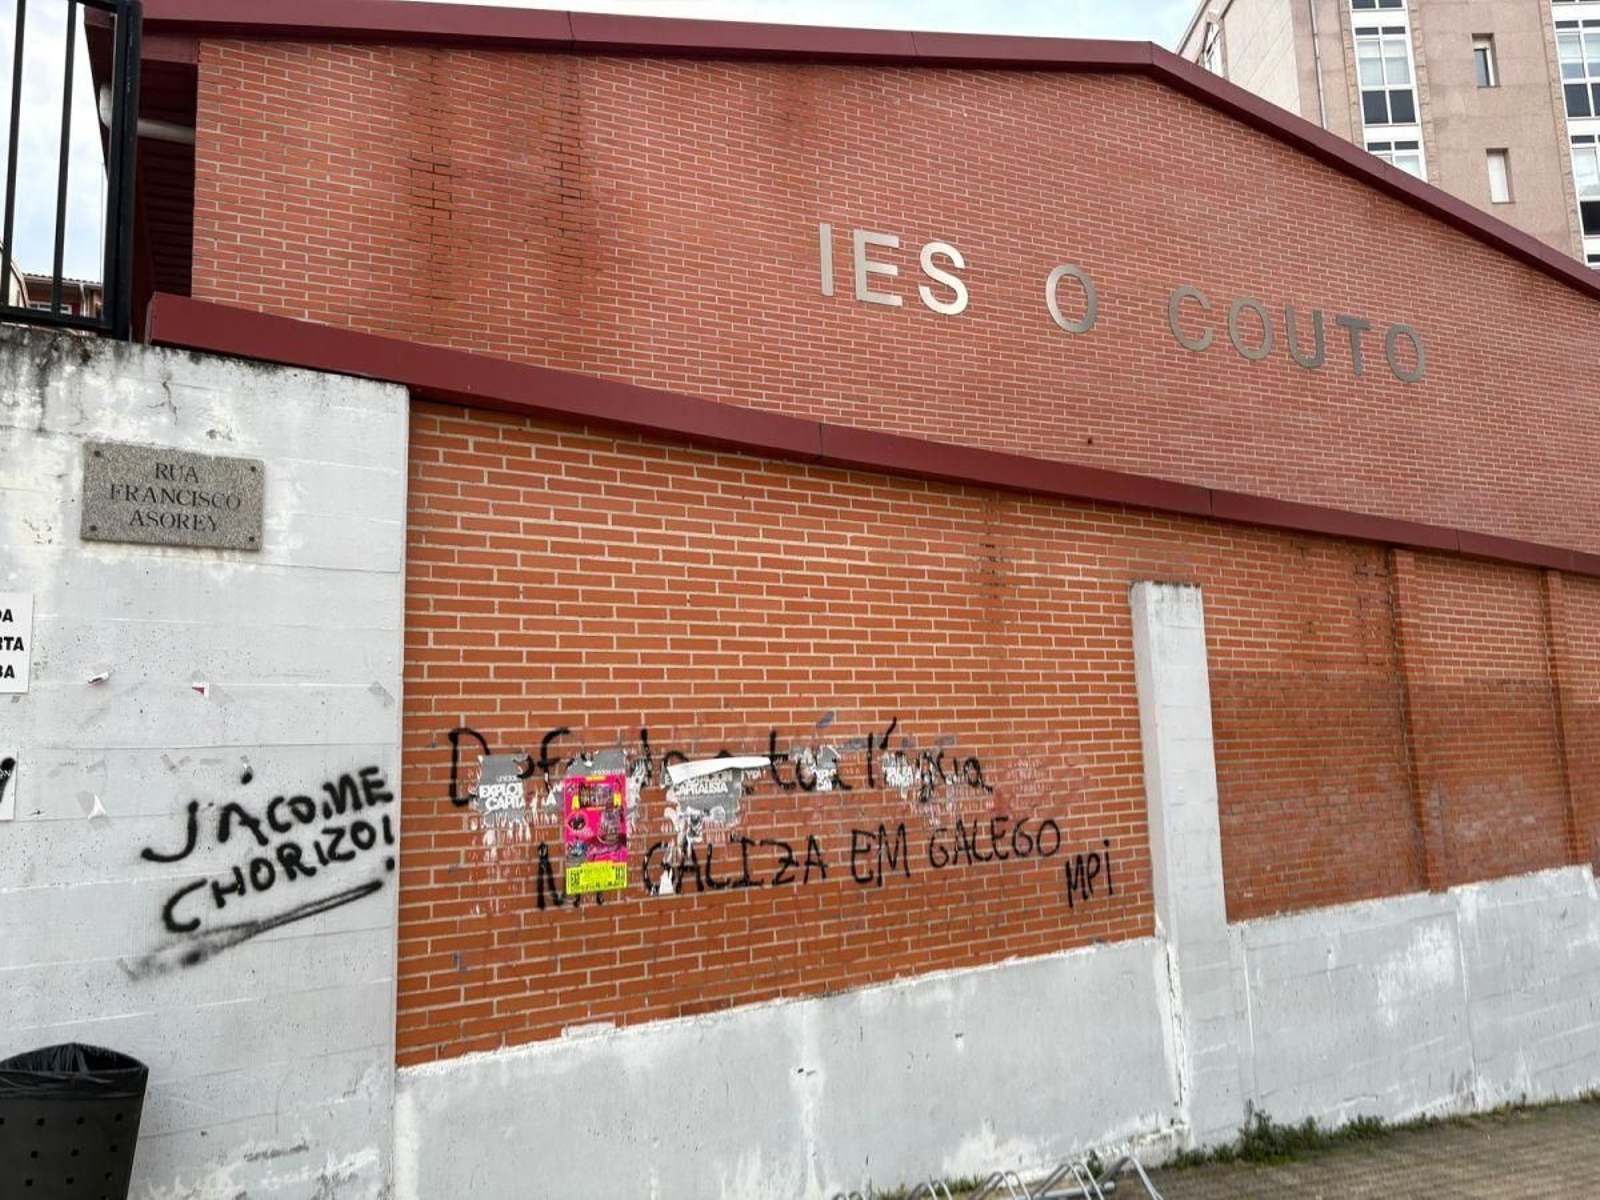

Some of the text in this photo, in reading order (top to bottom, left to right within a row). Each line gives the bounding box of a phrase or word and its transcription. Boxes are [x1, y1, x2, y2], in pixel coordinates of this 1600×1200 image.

[819, 223, 1426, 383] IES O COUTO
[110, 483, 241, 511] FRANCISCO
[129, 509, 221, 533] ASOREY
[0, 608, 14, 623] A
[0, 636, 25, 651] TA
[850, 822, 911, 888] EM
[929, 816, 1062, 869] GALEGO
